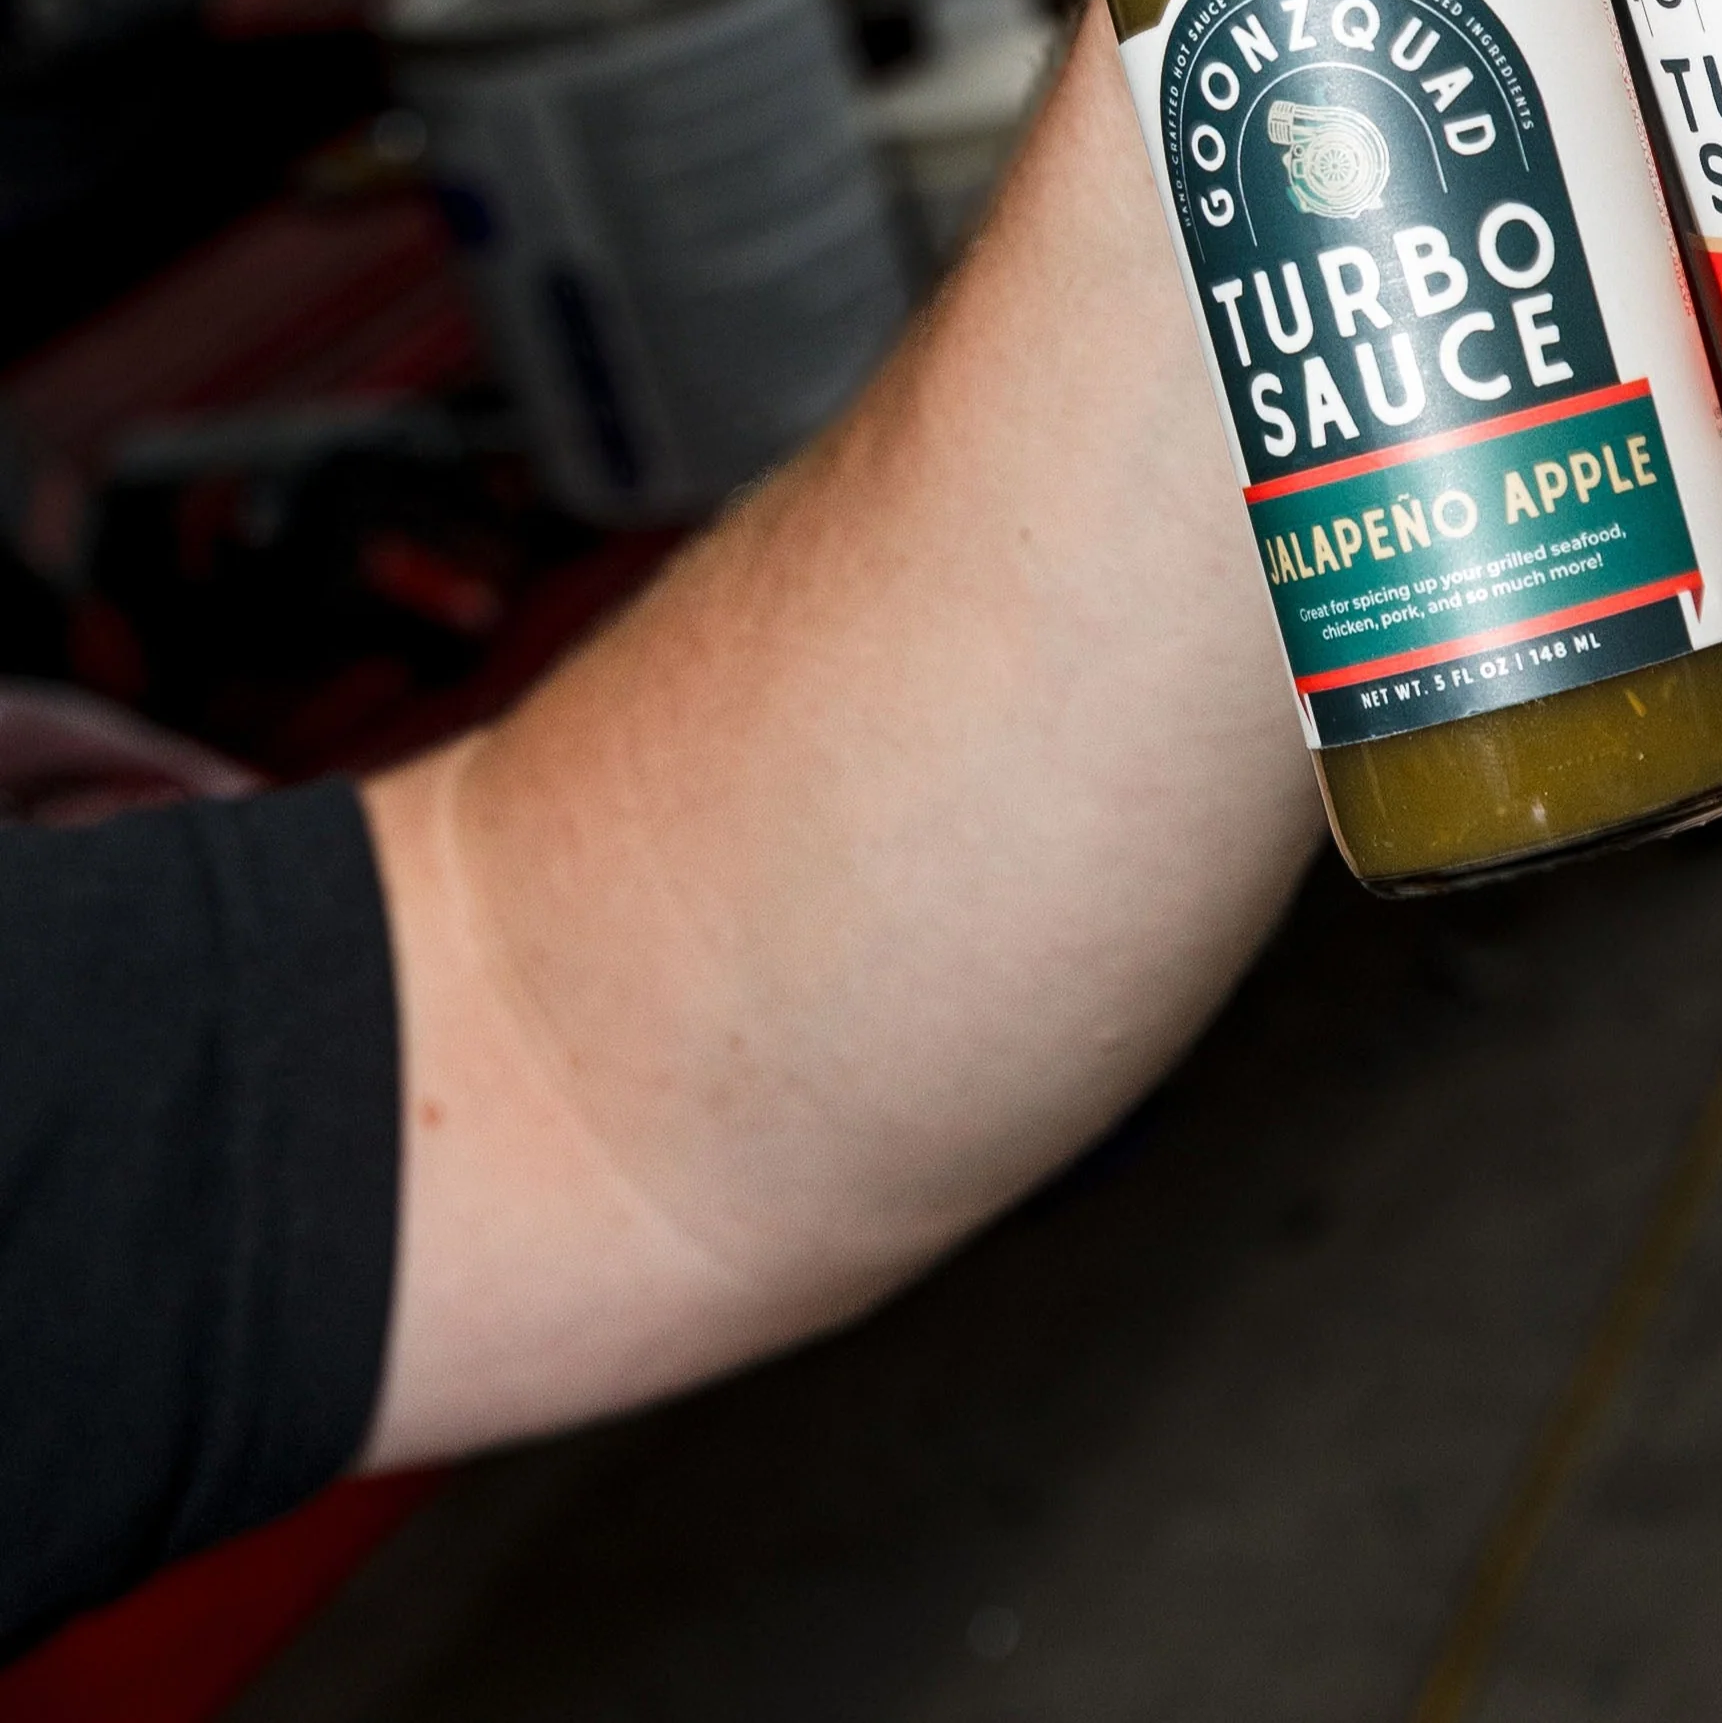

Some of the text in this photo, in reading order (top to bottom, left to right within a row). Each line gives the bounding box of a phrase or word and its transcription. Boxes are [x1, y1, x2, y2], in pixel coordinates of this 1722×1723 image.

[1173, 44, 1191, 79] HOT
[1465, 16, 1535, 131] INGREDIENTS
[1211, 202, 1556, 368] TURBO
[1250, 292, 1574, 458] SAUCE
[1266, 489, 1479, 586] JALAPEÑO
[1504, 434, 1658, 526] APPLE
[1299, 523, 1627, 623] Great for spicing up your grilled seafood,
[1322, 553, 1604, 641] chicken, pork, and so much more!
[1360, 688, 1390, 710] NET
[1394, 679, 1429, 702] WT.
[1435, 675, 1447, 692] 5
[1452, 667, 1475, 689] FL
[1479, 657, 1510, 678] OZ
[1529, 642, 1568, 666] 148
[1572, 632, 1602, 654] ML
